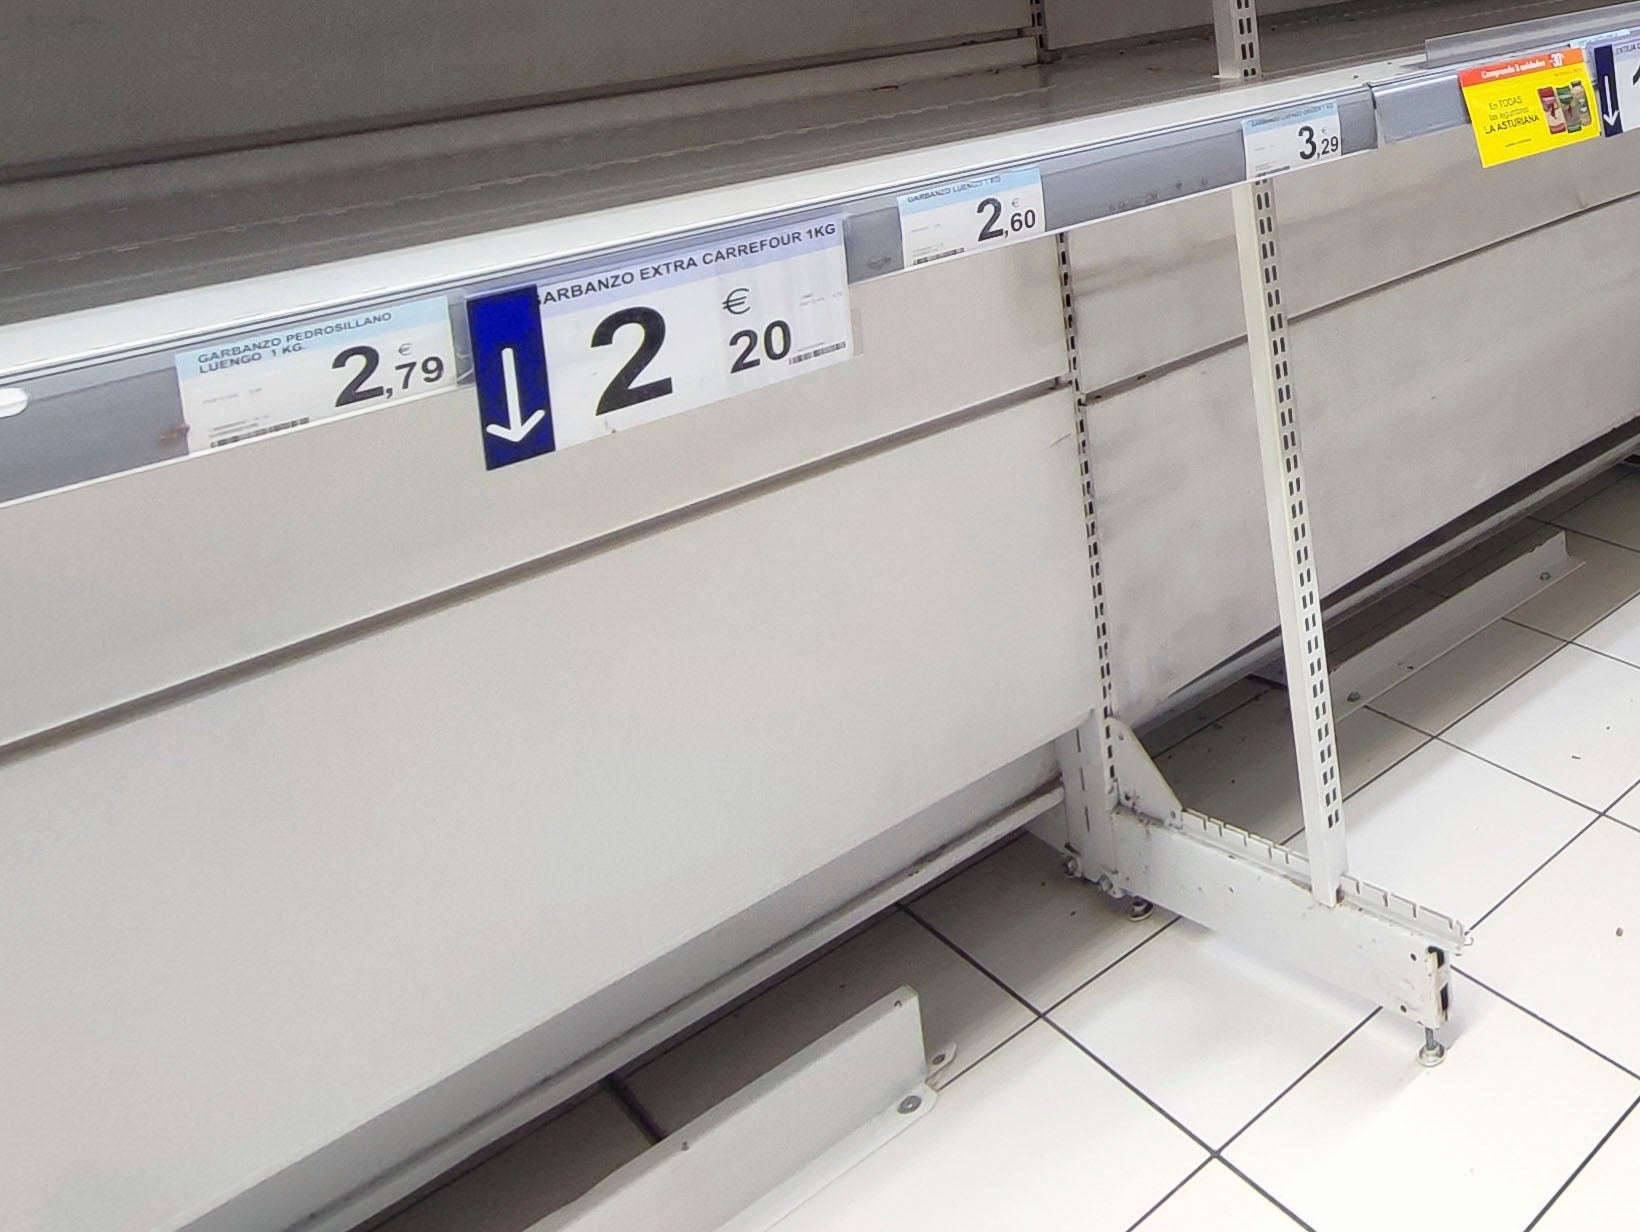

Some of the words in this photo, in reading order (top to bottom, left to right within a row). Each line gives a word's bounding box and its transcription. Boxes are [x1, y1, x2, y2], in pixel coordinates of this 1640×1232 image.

[1498, 95, 1523, 108] TODAS
[1497, 114, 1540, 132] ASTURIANA
[1298, 125, 1339, 160] 3,29
[907, 186, 952, 204] GARBANZO
[976, 197, 1037, 243] 2,60
[534, 271, 635, 306] ARBANZO
[639, 256, 699, 282] EXTRA
[701, 230, 803, 266] CARREFOUR
[805, 222, 837, 241] 1KG
[721, 287, 752, 316] €
[197, 336, 282, 365] GARBANZO
[285, 312, 393, 345] PEDROSILLANO
[397, 342, 415, 357] €
[198, 351, 263, 375] LUENGO
[270, 347, 279, 358] 1
[331, 345, 445, 408] 2,79
[590, 305, 674, 418] 2
[728, 319, 792, 375] 20
